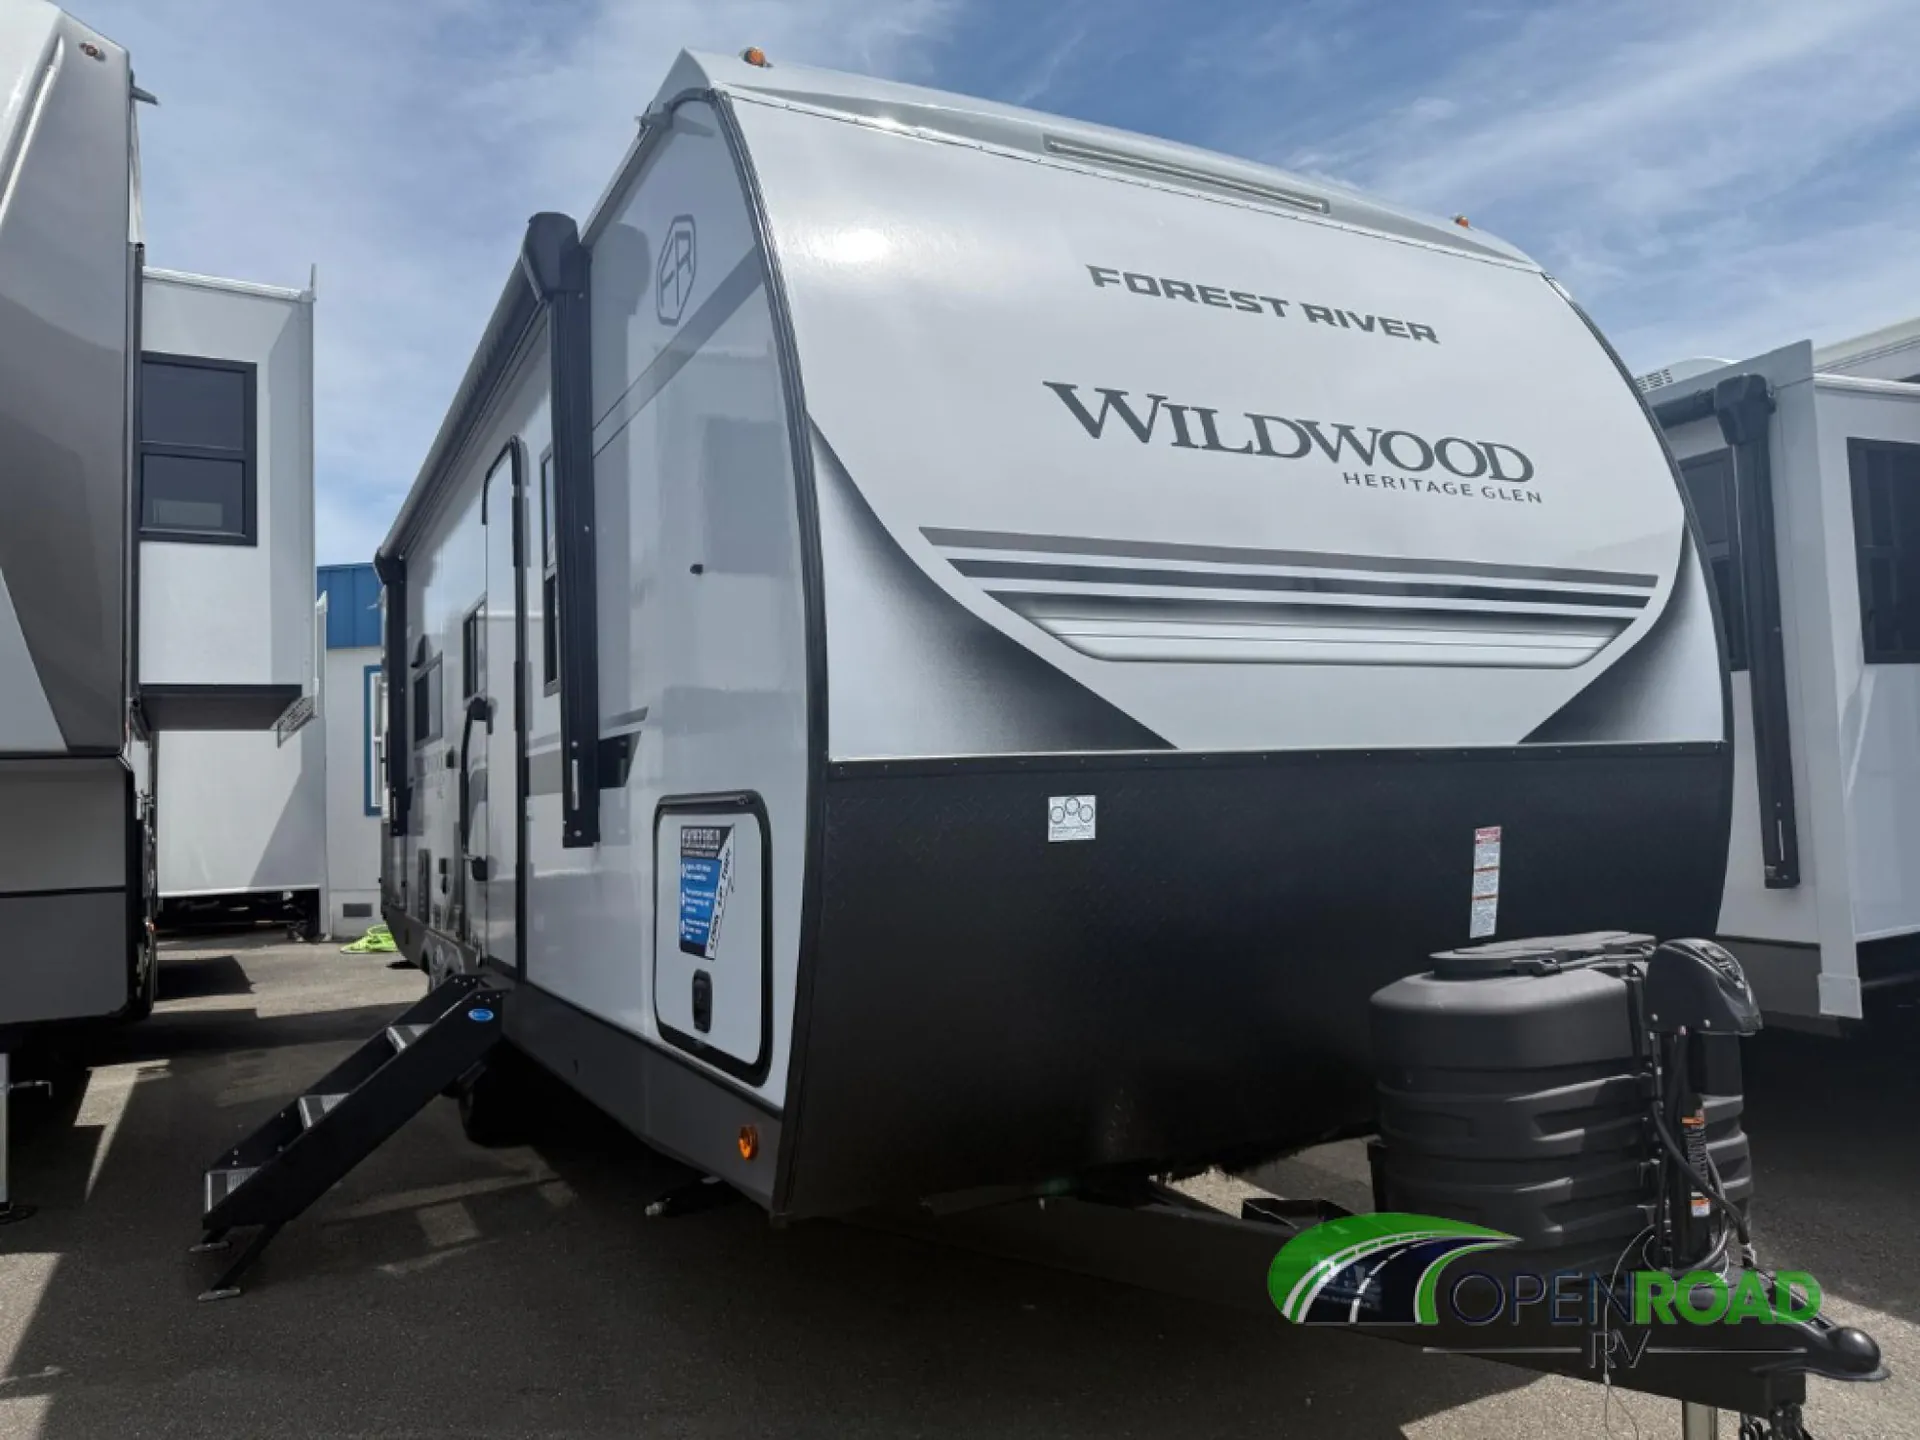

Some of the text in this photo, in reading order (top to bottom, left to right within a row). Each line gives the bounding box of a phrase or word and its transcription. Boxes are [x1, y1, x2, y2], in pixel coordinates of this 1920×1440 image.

[1086, 264, 1440, 344] FOREST RIVER
[1042, 380, 1534, 483] WILDWOOD
[1344, 472, 1543, 504] HERITAGE GLEN
